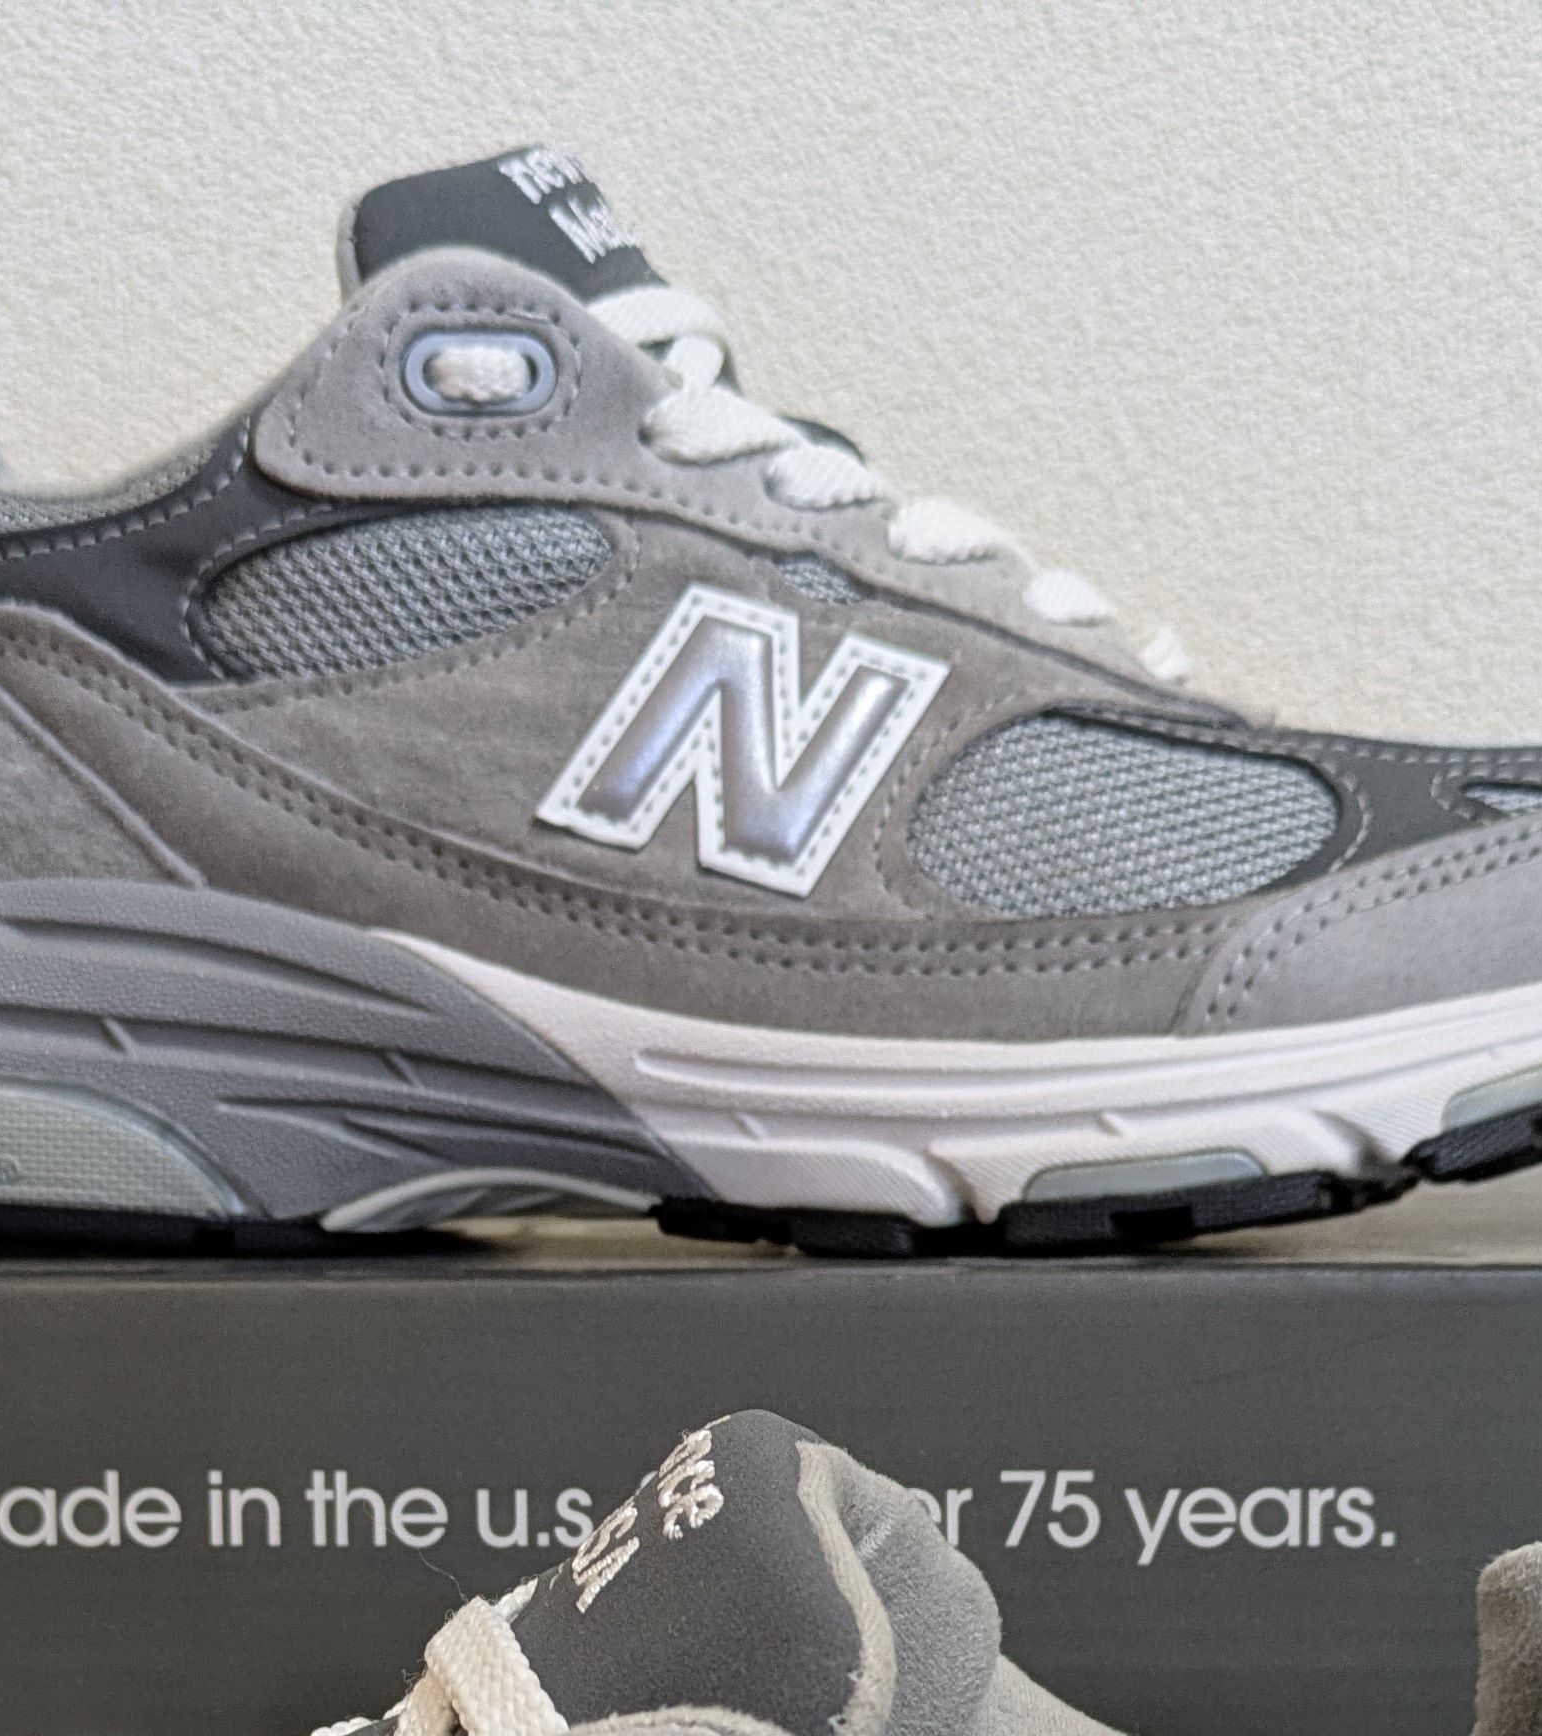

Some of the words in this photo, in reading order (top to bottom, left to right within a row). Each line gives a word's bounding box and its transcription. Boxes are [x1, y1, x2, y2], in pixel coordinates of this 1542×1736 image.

[535, 582, 952, 898] N
[208, 1469, 282, 1547] in
[304, 1469, 449, 1549] the
[476, 1487, 594, 1549] u.s
[999, 1469, 1101, 1549] 75
[1124, 1487, 1396, 1566] years.
